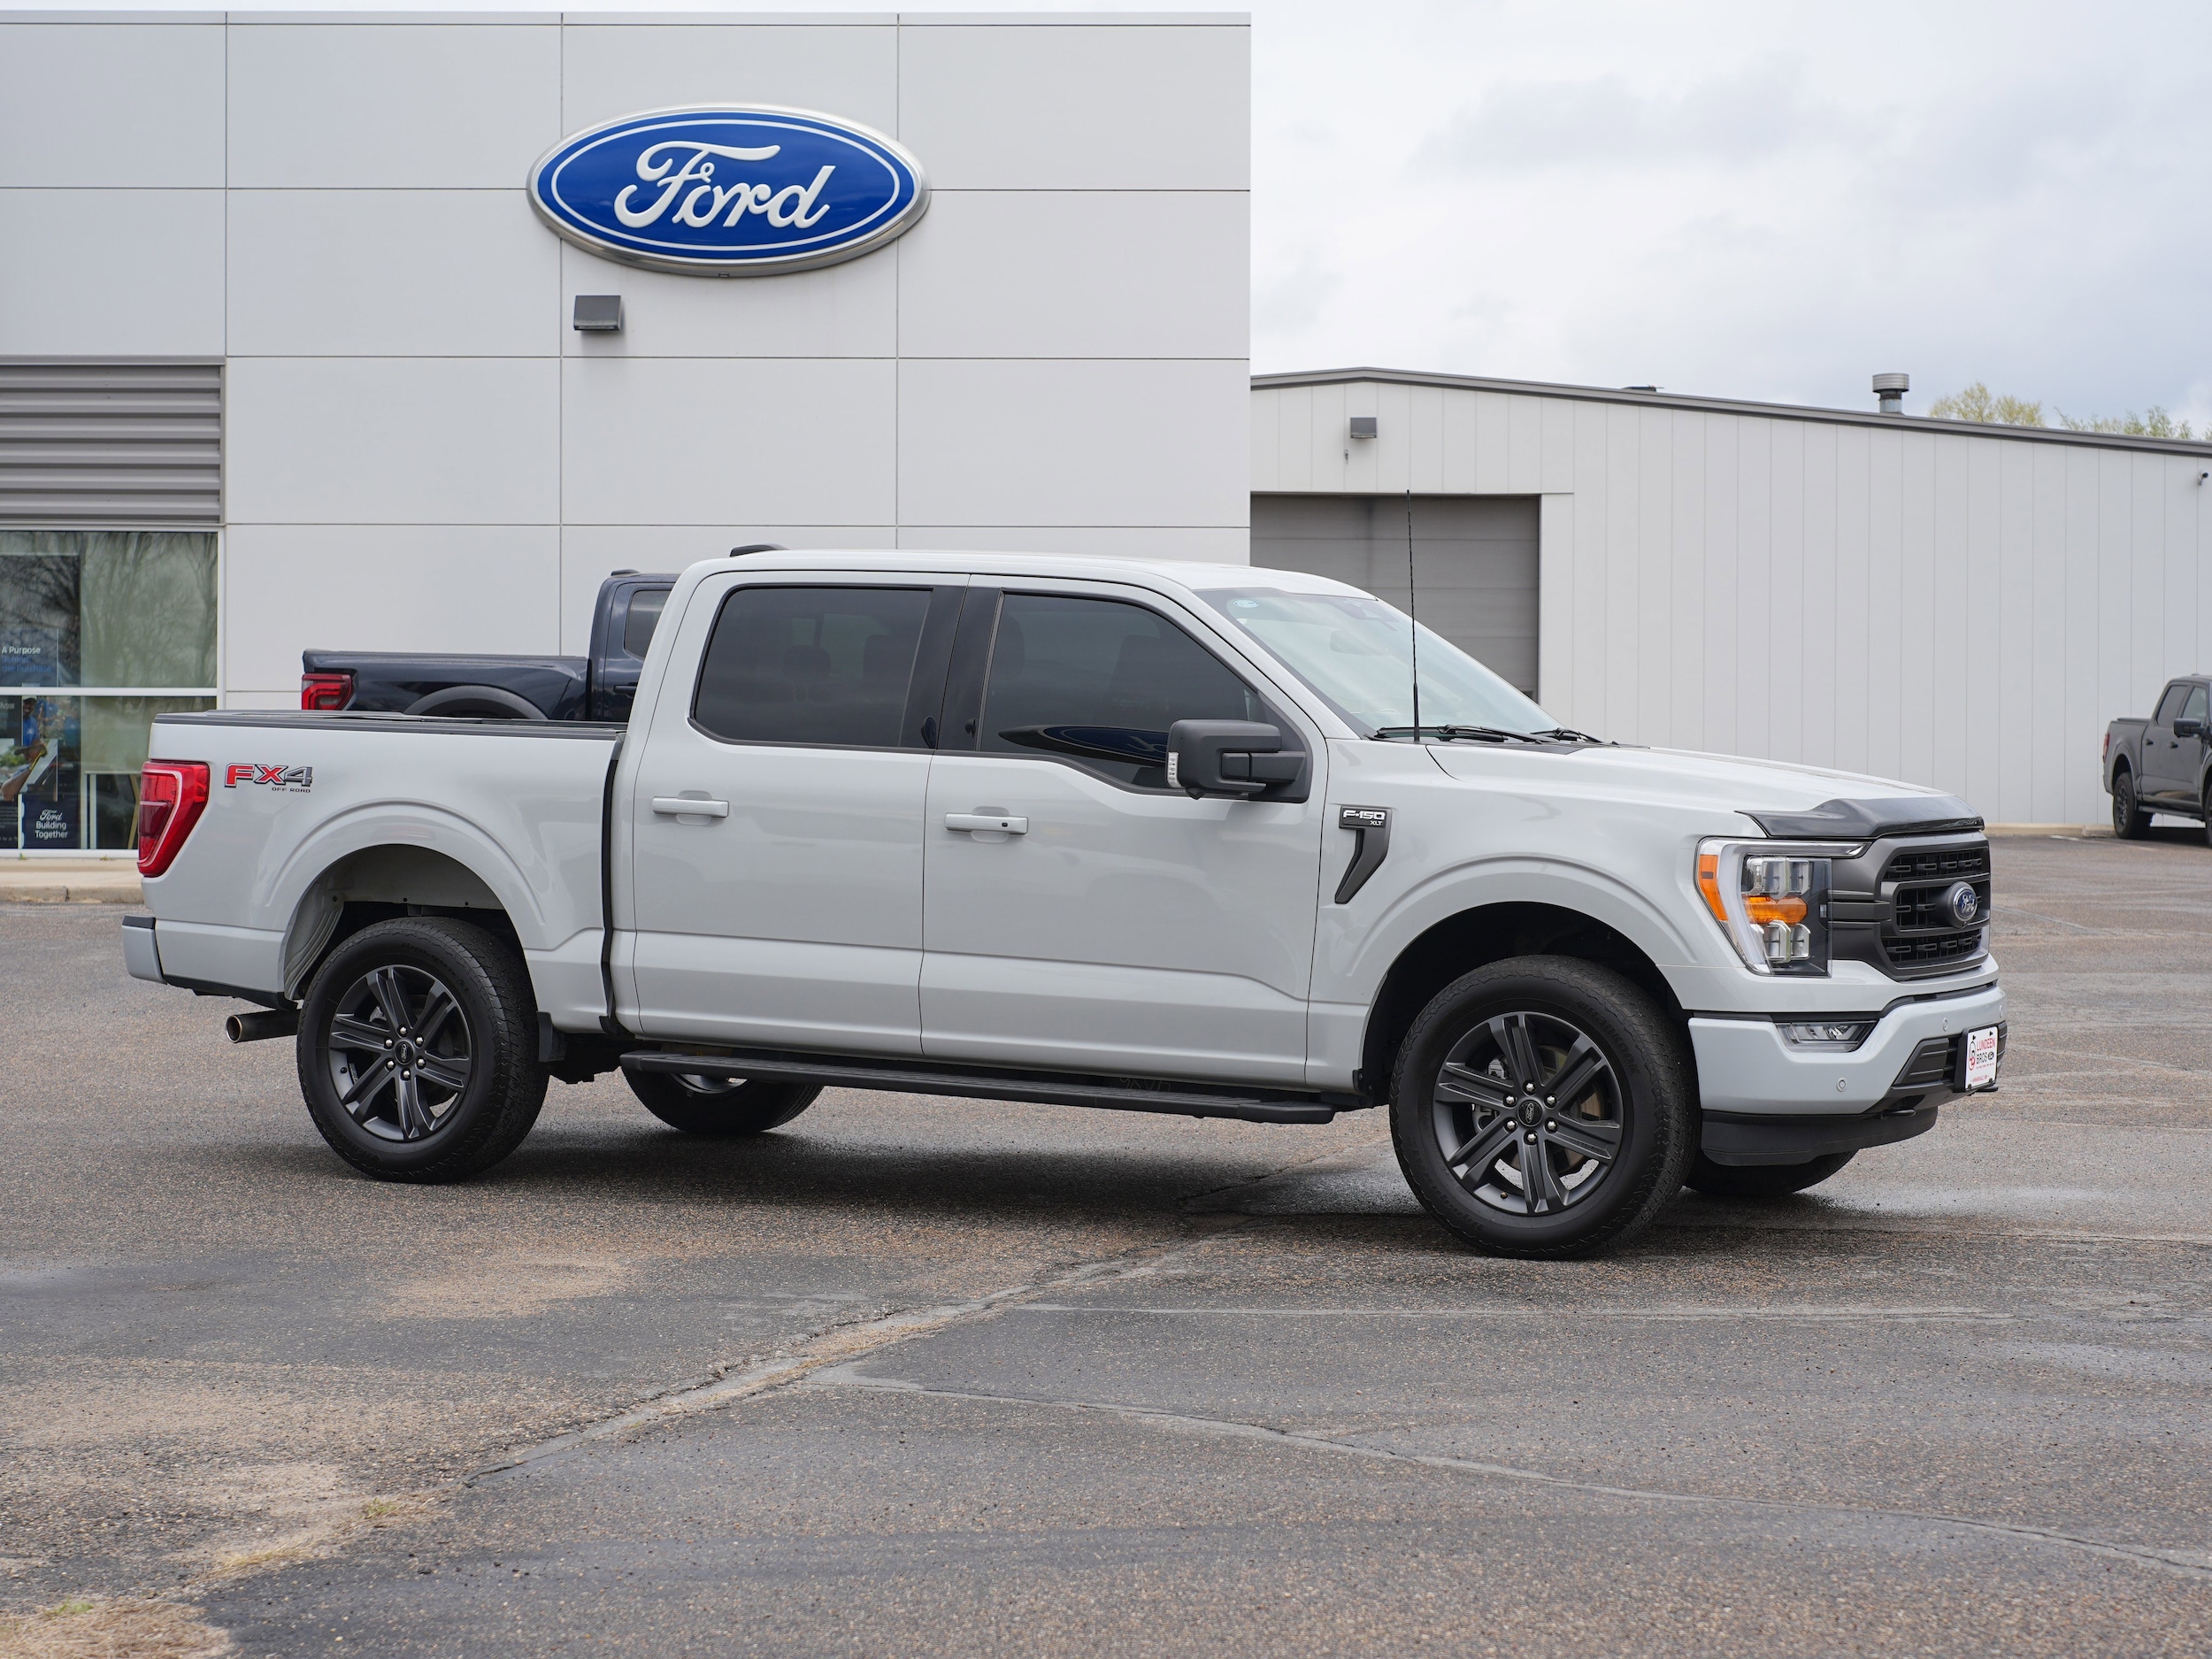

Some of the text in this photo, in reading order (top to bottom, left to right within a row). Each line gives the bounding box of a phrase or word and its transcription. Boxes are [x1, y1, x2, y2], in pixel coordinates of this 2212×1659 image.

[613, 140, 836, 229] Ford
[1, 646, 42, 656] A Purpose
[224, 762, 313, 788] FX4
[39, 809, 63, 821] Ford
[1342, 810, 1386, 820] F-150
[35, 821, 67, 831] Building
[35, 830, 68, 840] Together
[1977, 1037, 1996, 1051] LUNDEEN
[1976, 1051, 1988, 1064] BROS
